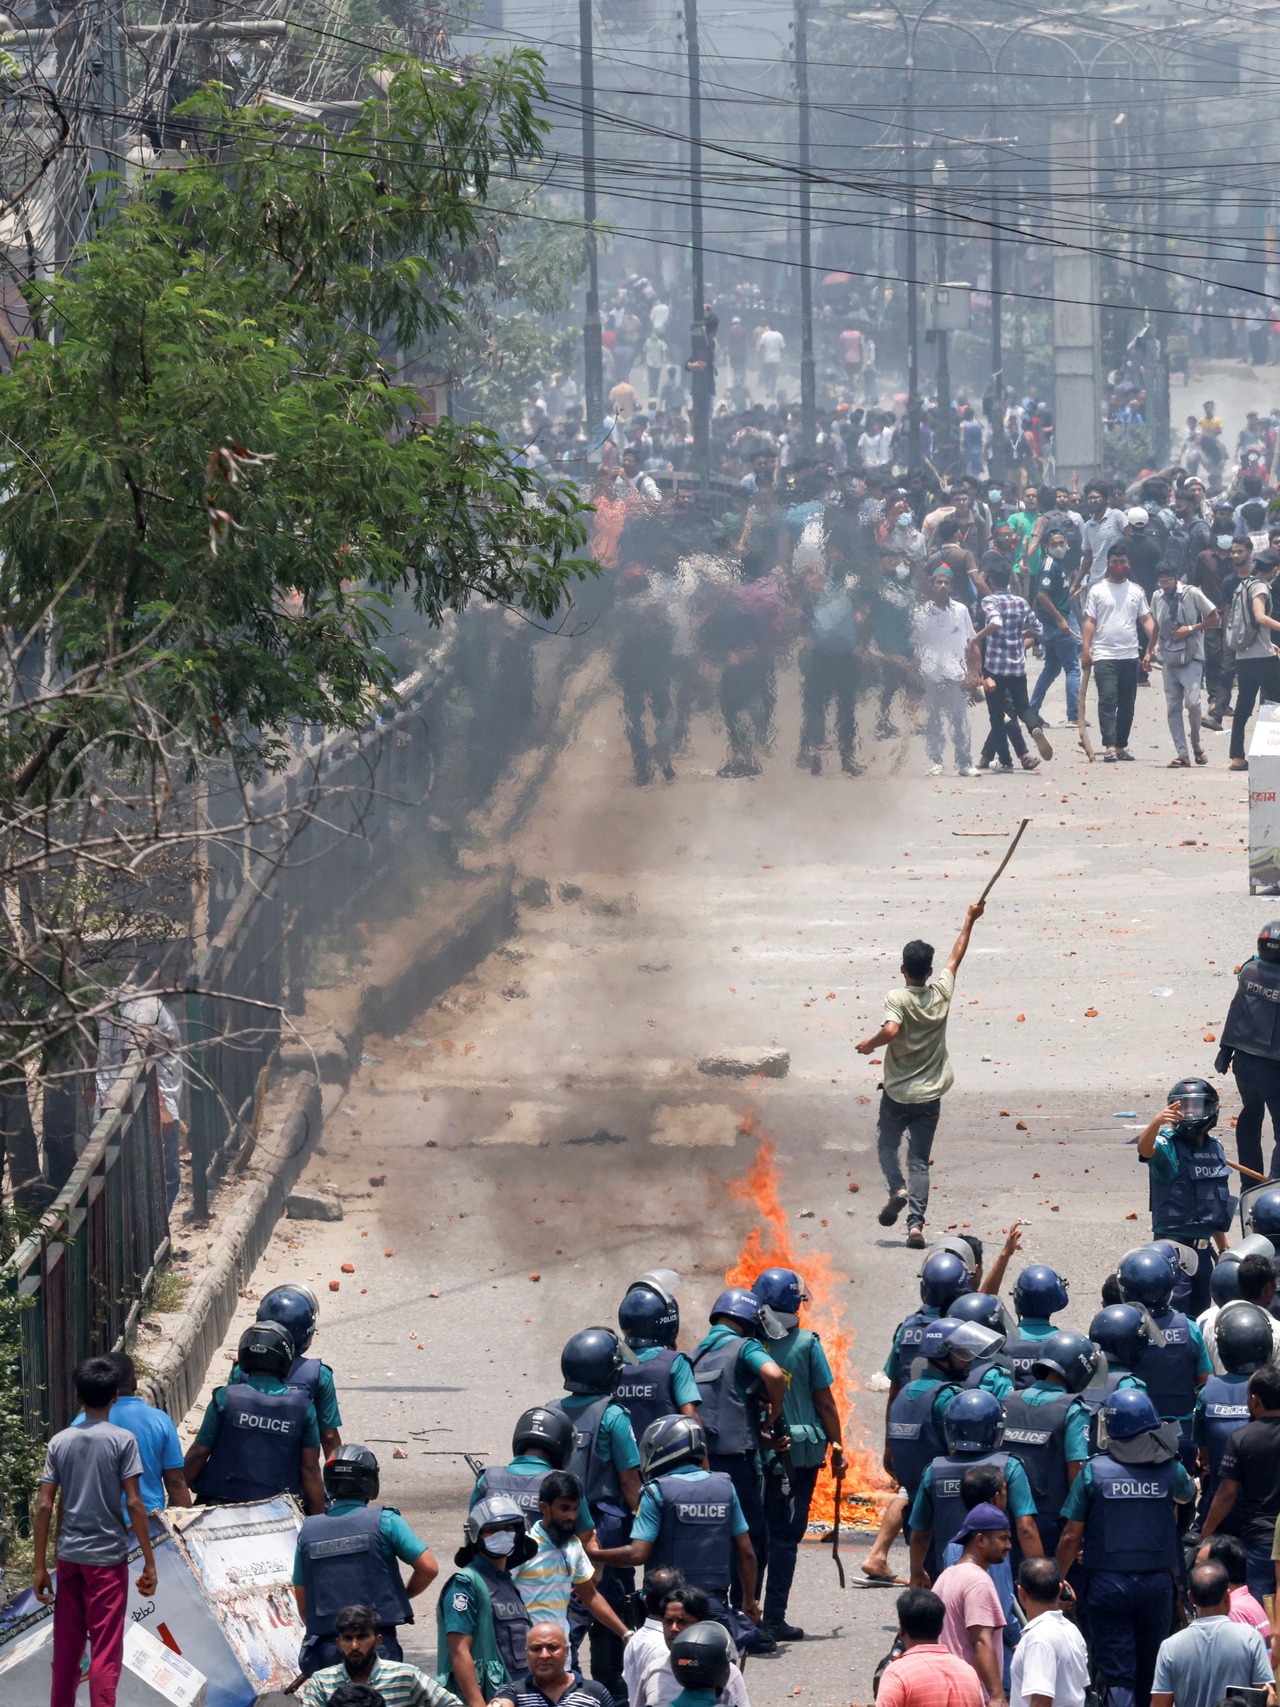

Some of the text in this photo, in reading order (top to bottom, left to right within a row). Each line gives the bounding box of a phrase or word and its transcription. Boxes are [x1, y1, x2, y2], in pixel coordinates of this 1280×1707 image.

[1246, 981, 1280, 1000] POLICE
[741, 1296, 757, 1307] POLICE
[926, 1332, 943, 1340] POLICE
[1077, 1353, 1094, 1374] POLICE
[618, 1385, 652, 1398] OLICE
[1221, 1405, 1249, 1415] POLICE
[239, 1412, 291, 1433] POLICE
[1004, 1428, 1050, 1444] POLICE
[1112, 1482, 1160, 1496] POLICE
[680, 1504, 726, 1518] POLICE
[320, 1537, 360, 1551] POLICE
